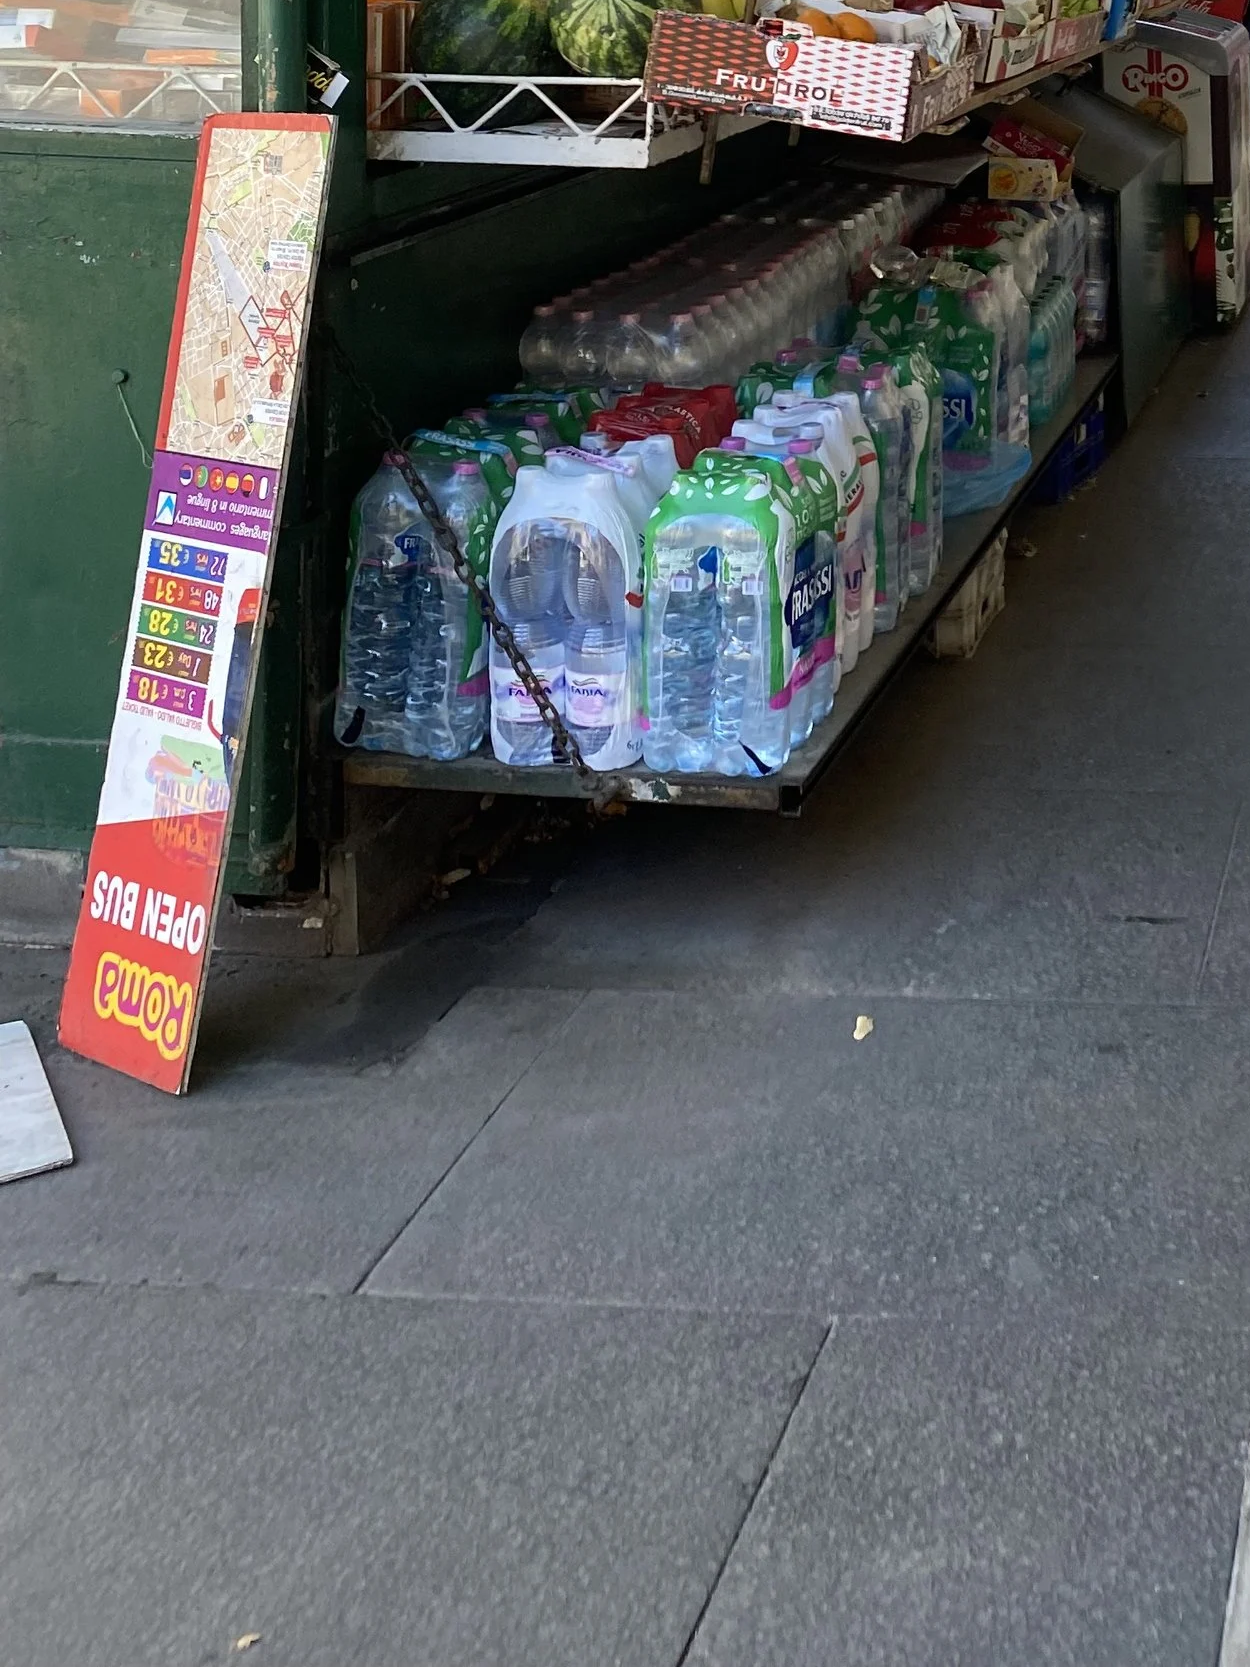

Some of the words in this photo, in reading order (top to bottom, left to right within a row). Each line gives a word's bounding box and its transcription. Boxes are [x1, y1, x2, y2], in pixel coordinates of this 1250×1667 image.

[211, 499, 219, 514] 8
[174, 510, 227, 534] commentary
[204, 590, 220, 611] 48
[199, 624, 214, 645] 24
[187, 690, 197, 711] 3
[90, 870, 140, 931] BUS
[139, 887, 206, 956] OPEN
[93, 952, 192, 1061] Roma
